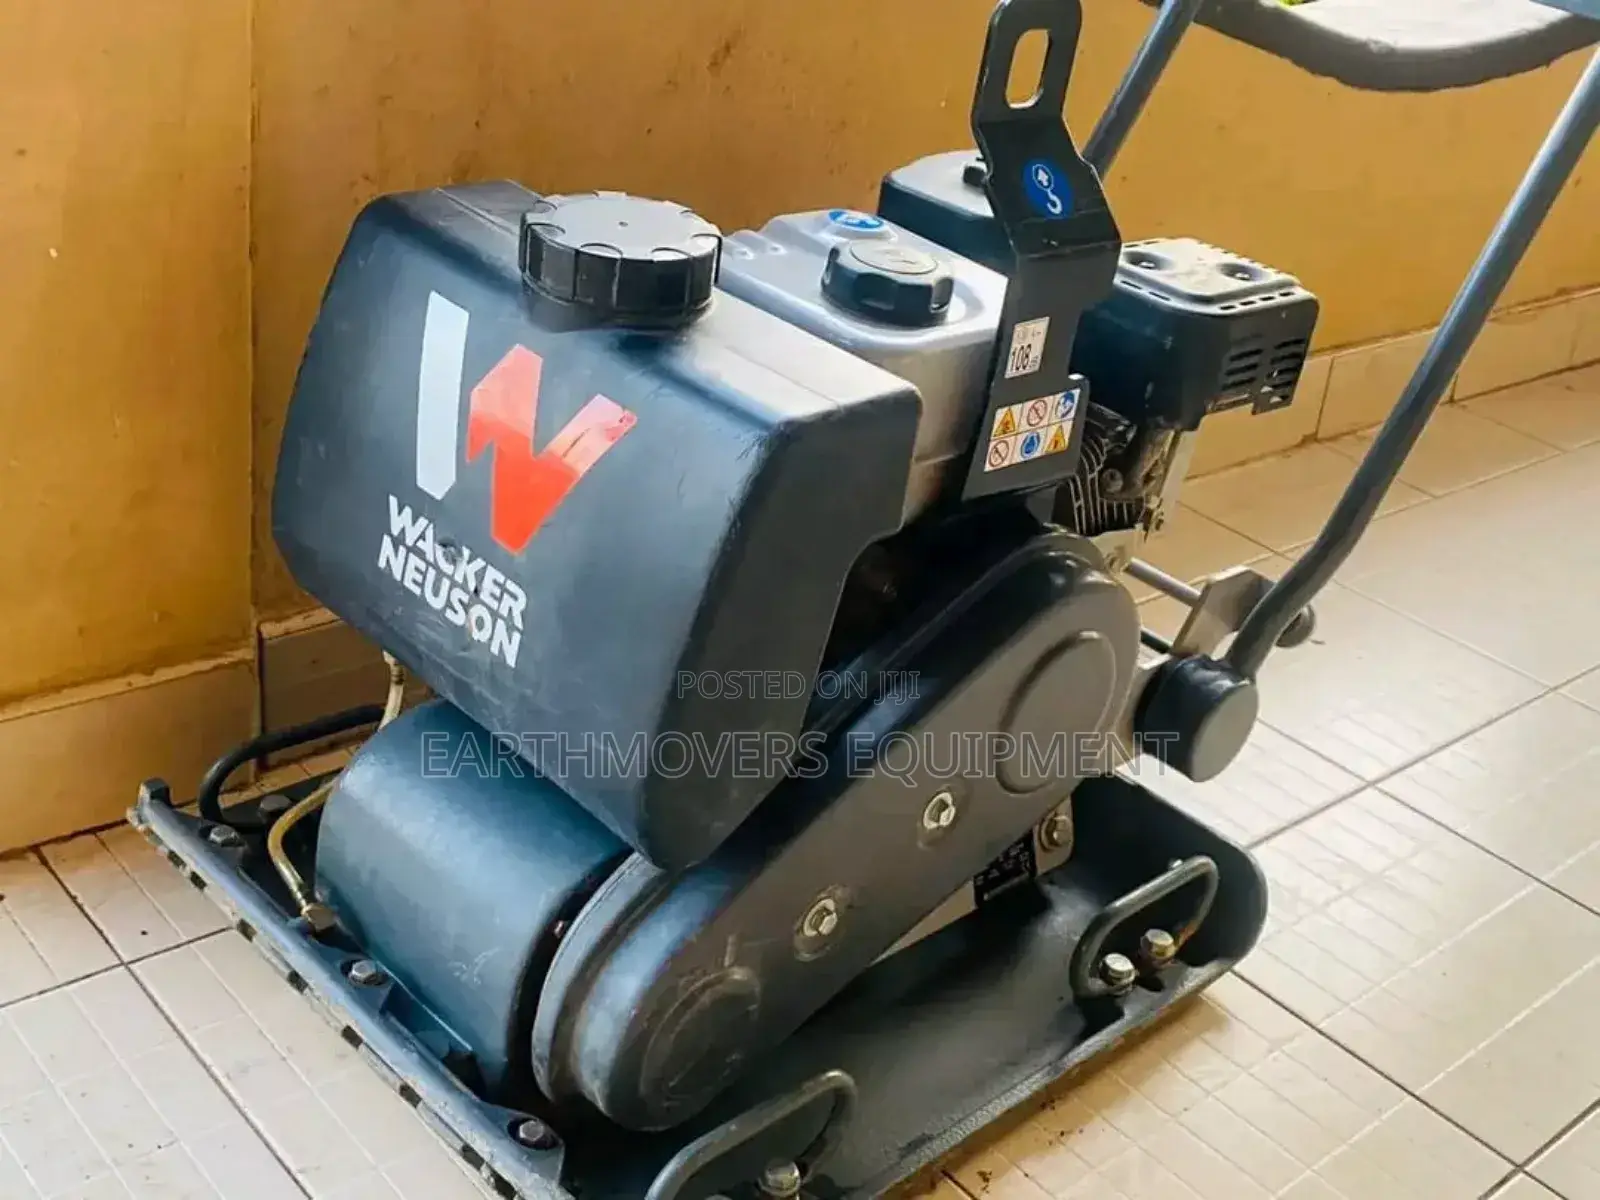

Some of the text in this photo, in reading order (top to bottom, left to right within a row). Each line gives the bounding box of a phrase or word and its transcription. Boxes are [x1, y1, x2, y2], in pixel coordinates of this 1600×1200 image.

[1011, 343, 1032, 372] 108
[378, 533, 522, 669] NEUSON
[389, 494, 528, 630] WACKER
